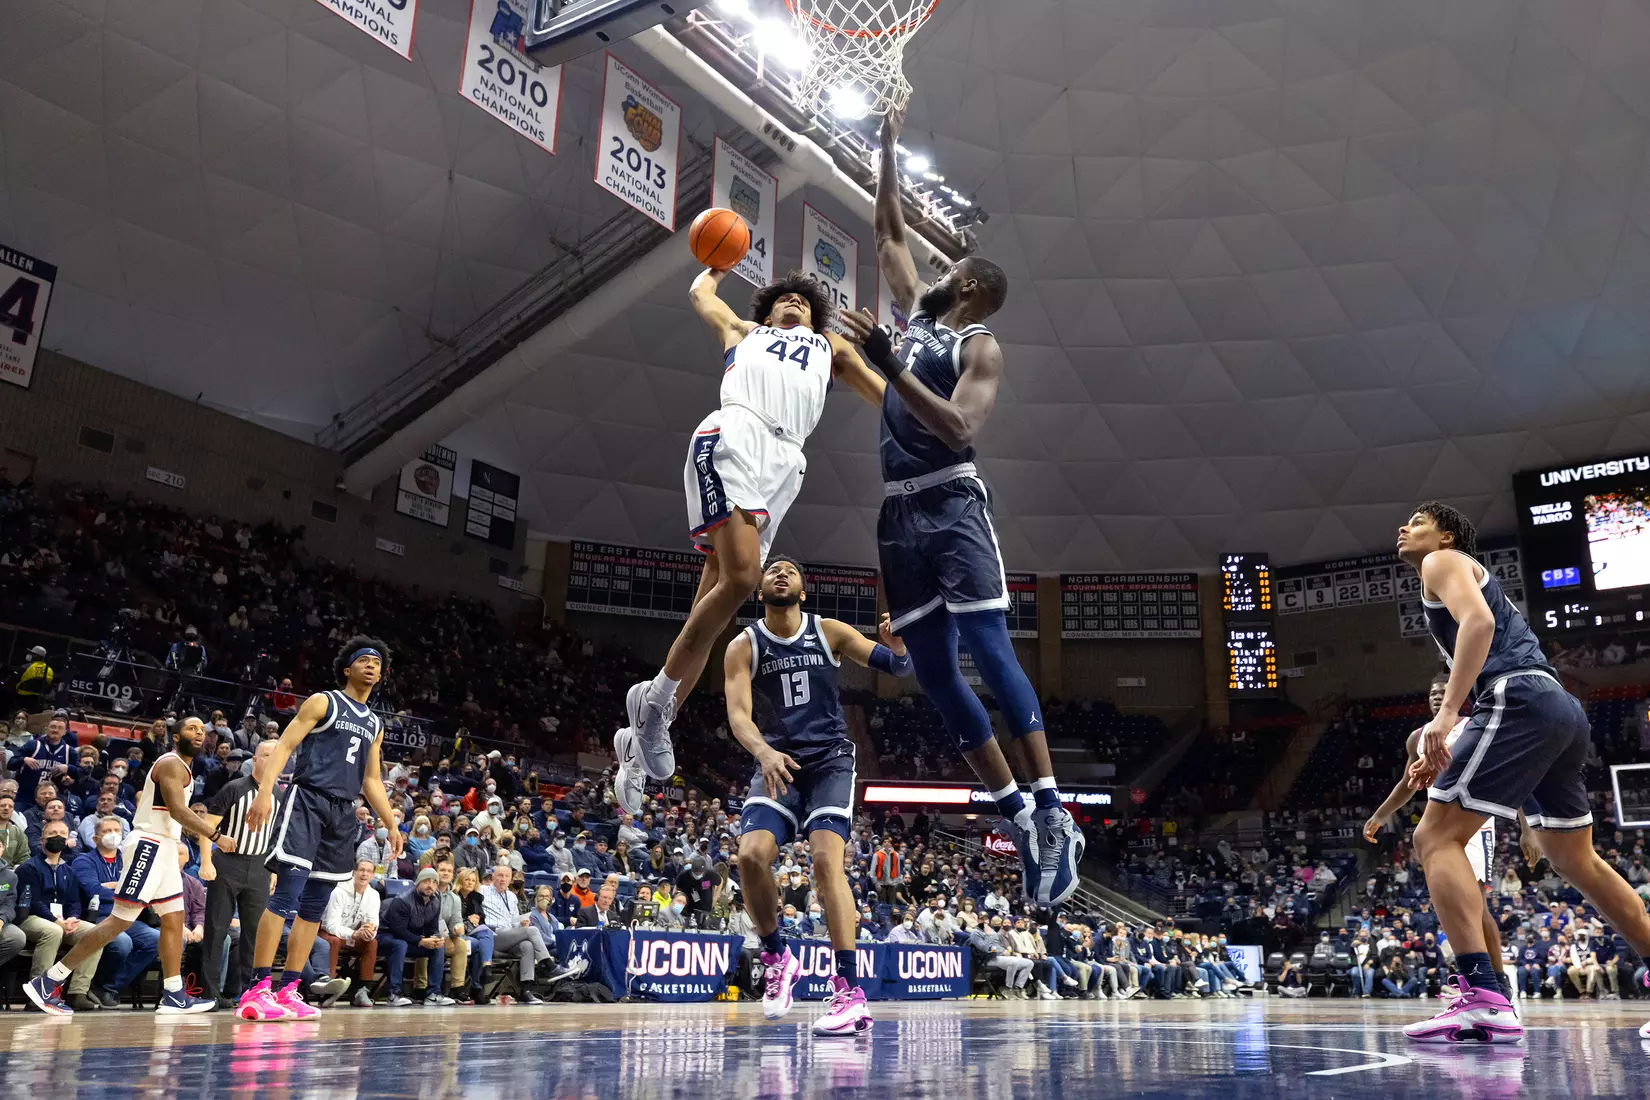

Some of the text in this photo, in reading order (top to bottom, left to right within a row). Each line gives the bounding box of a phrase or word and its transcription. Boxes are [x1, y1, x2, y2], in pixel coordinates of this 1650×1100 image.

[330, 0, 399, 45] AMPIONS
[477, 44, 548, 108] 2010
[613, 61, 675, 112] UConn Women's
[479, 75, 542, 124] NATIONAL
[624, 81, 664, 115] Basketball
[472, 88, 546, 142] CHAMPIONS
[609, 136, 666, 190] 2013
[721, 142, 773, 184] UConn Women's
[730, 159, 764, 189] Basketball
[611, 163, 663, 205] NATIONAL
[605, 176, 666, 221] CHAMPIONS
[748, 228, 767, 259] 14
[0, 248, 34, 271] ALLEN
[735, 263, 768, 287] MPIONS
[755, 326, 828, 353] UCONN
[766, 339, 811, 371] 44
[905, 341, 925, 372] 5
[164, 474, 185, 488] 210
[696, 440, 719, 517] HUSKIES
[1540, 455, 1650, 487] UNIVERSITY
[904, 480, 915, 492] G
[1530, 501, 1572, 516] WELLS
[1533, 511, 1573, 526] FARGO
[573, 543, 706, 565] BIG EAST CONFERENC
[1325, 554, 1398, 570] UCONN HUSKIE
[659, 561, 705, 571] CHAMPIO
[1495, 565, 1518, 579] 42
[1541, 567, 1575, 581] CBS
[814, 575, 865, 584] CHAMPIONS
[1068, 575, 1191, 584] NCAA CHAMPIONSHIP
[1369, 582, 1391, 597] 25
[1400, 577, 1421, 592] 42
[859, 586, 875, 597] 2011
[1284, 594, 1298, 607] C
[1316, 590, 1325, 603] 9
[1339, 586, 1361, 601] 22
[569, 602, 627, 614] CONNECTICUT
[1545, 610, 1558, 628] 5
[1403, 615, 1426, 630] 24
[760, 653, 825, 676] GEORGETOWN
[71, 679, 133, 701] SEC 109
[780, 670, 811, 708] 13
[334, 720, 375, 745] GEORGETOWN
[384, 731, 427, 747] SEC 109
[345, 735, 362, 765] 2
[126, 844, 153, 896] HUSKIES
[628, 939, 730, 977] UCONN
[800, 945, 875, 979] UCN
[898, 950, 963, 980] UCONN
[908, 984, 952, 993] BASKETBALL
